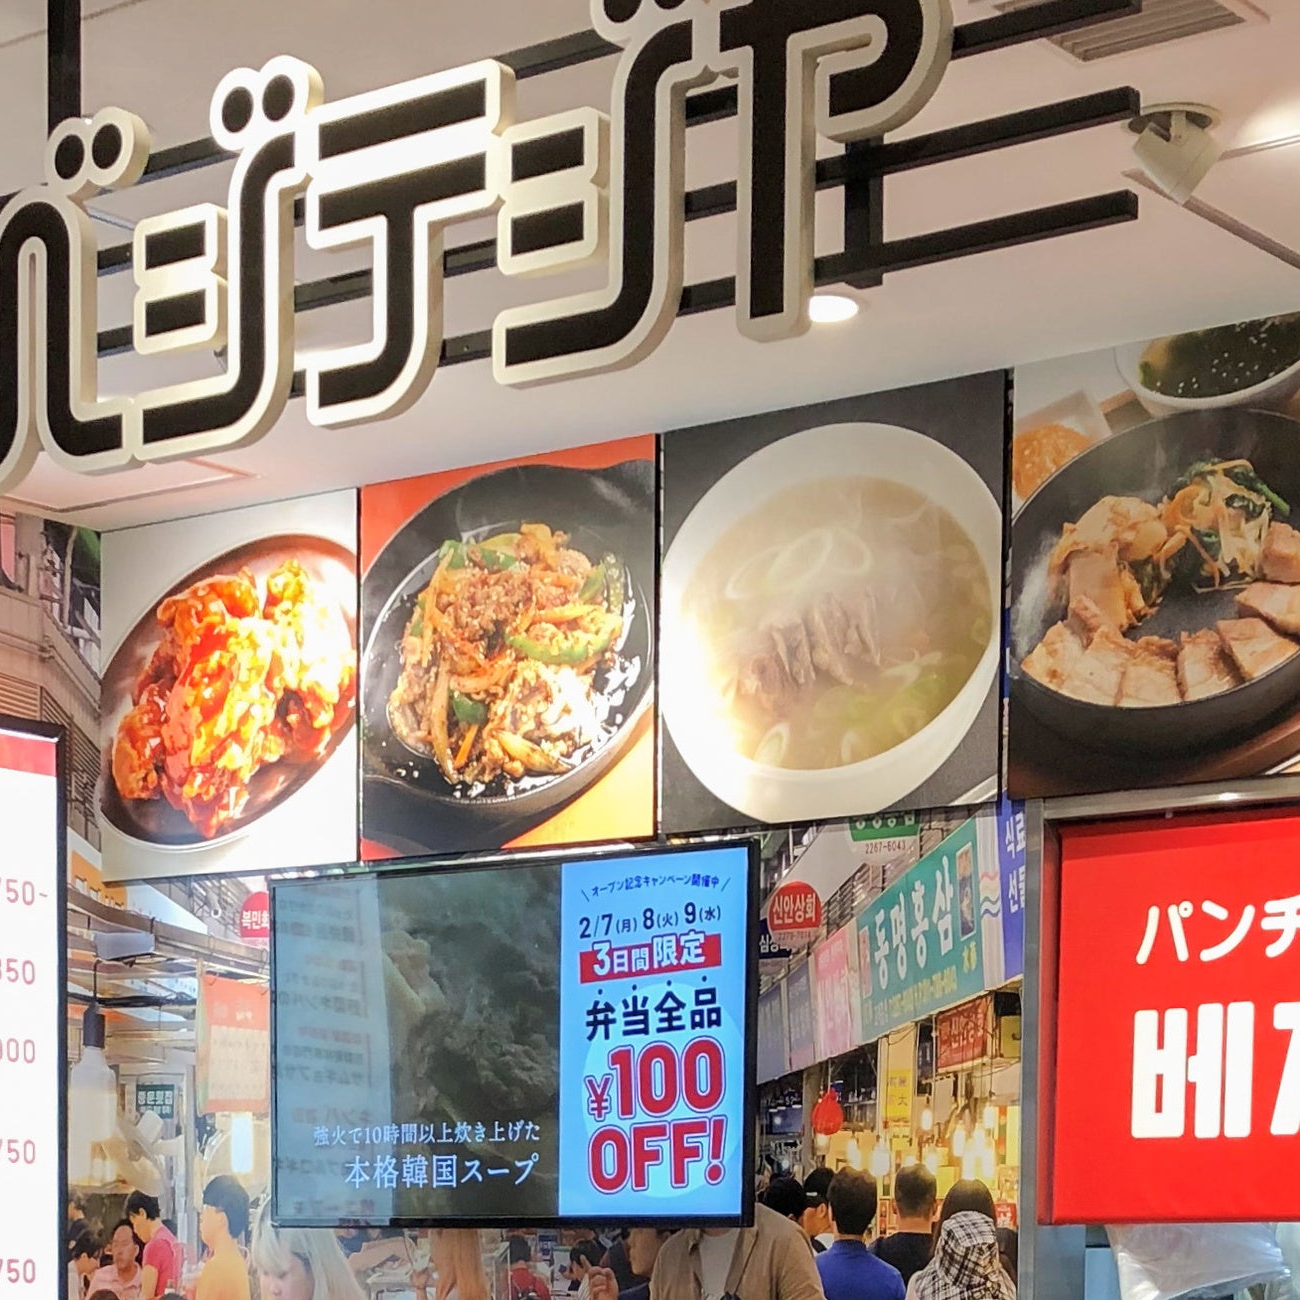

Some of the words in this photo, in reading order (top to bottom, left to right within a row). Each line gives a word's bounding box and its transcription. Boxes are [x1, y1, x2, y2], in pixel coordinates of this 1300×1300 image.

[773, 892, 816, 925] 신안상회
[874, 855, 954, 990] 동명홍삼
[592, 931, 706, 977] 3日間限定
[586, 987, 722, 1042] 弁当全品
[586, 1037, 724, 1120] ¥100
[313, 1119, 541, 1146] 強火で10時間以上炊き上げた
[588, 1119, 727, 1195] OFF!
[345, 1152, 541, 1189] 本格韓国スープ
